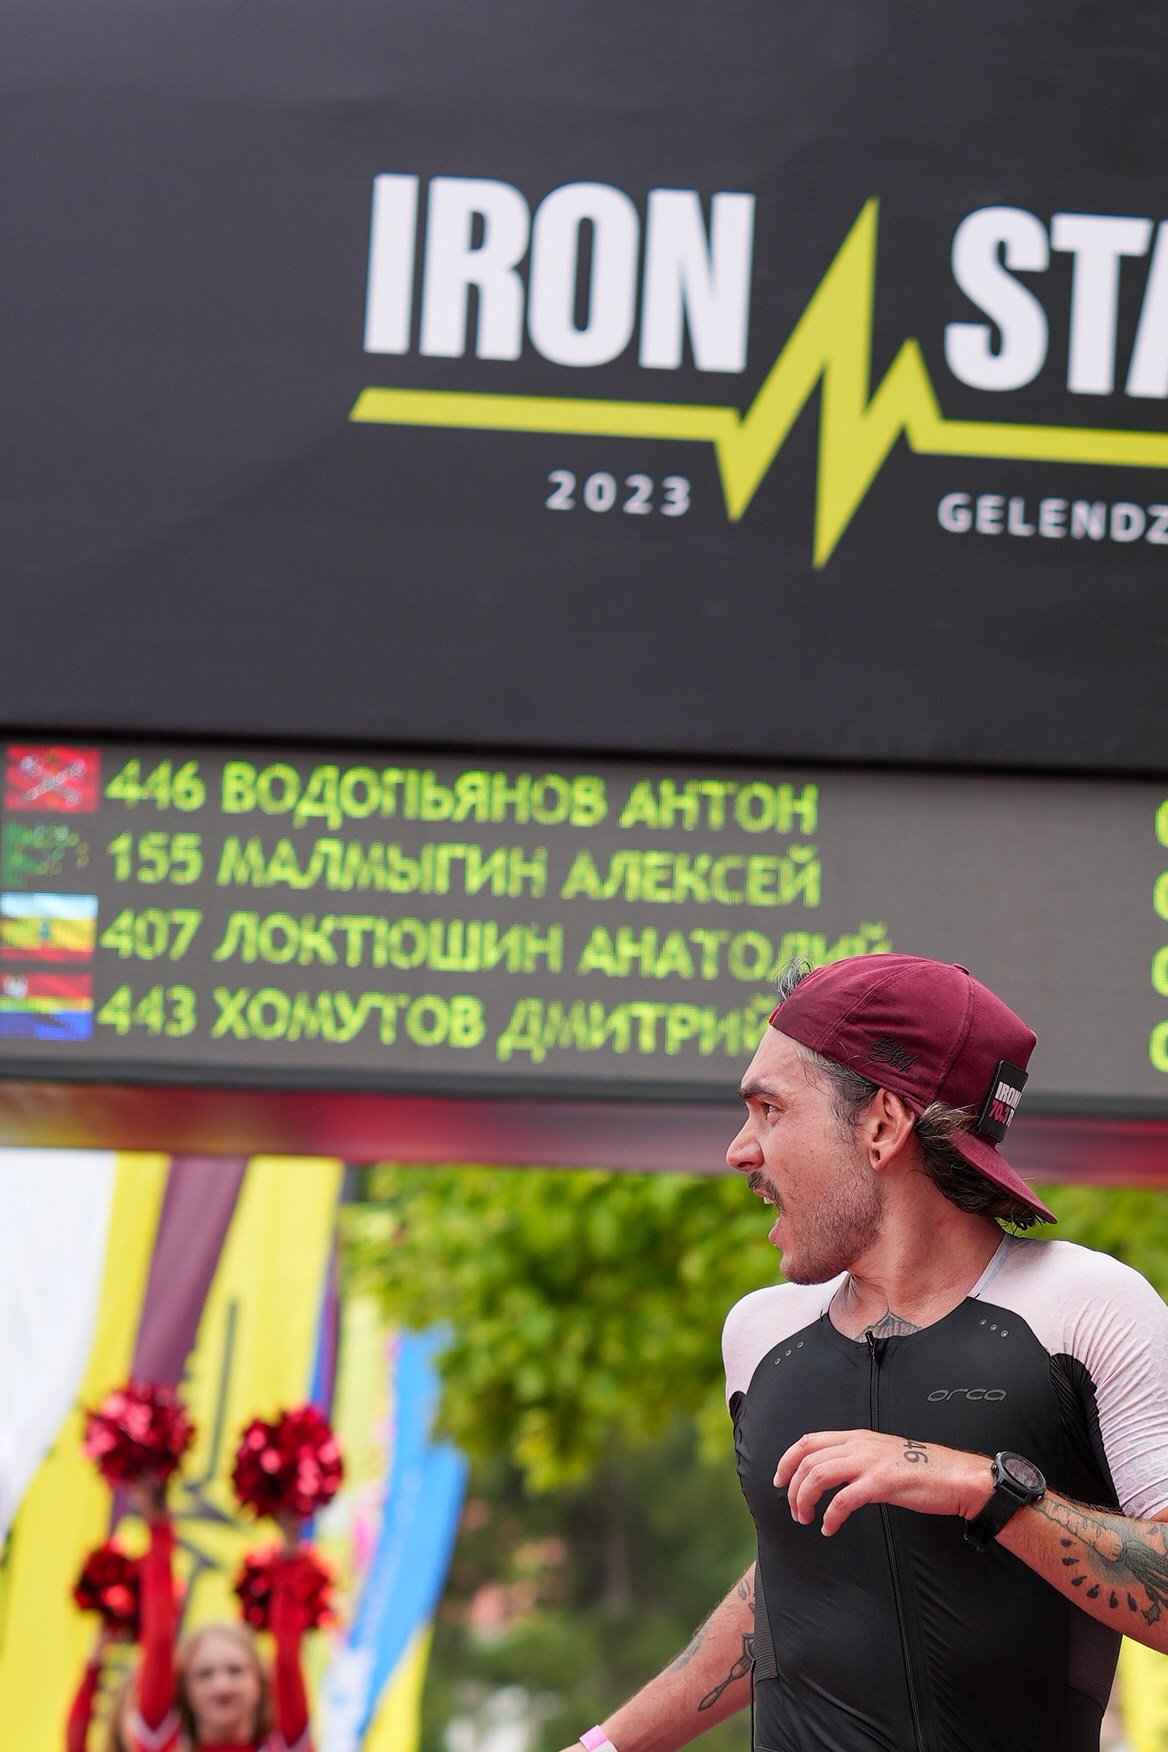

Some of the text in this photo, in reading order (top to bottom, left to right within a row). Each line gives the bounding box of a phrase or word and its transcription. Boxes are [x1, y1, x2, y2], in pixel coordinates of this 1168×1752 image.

[364, 173, 755, 373] IRON
[545, 469, 691, 517] 2023
[106, 758, 206, 812] 446
[220, 759, 608, 830] ВОДОПЬЯНОВ
[618, 778, 819, 835] АНТОН
[108, 831, 204, 884] 155
[216, 835, 547, 898] МАЛМЫГИН
[561, 844, 822, 907] АЛЕКСЕЙ
[99, 907, 203, 960] 407
[213, 910, 564, 973] ЛОКТЮШИН
[97, 984, 197, 1037] 443
[211, 986, 486, 1048] ХОМУТОВ
[927, 1388, 1007, 1402] orca
